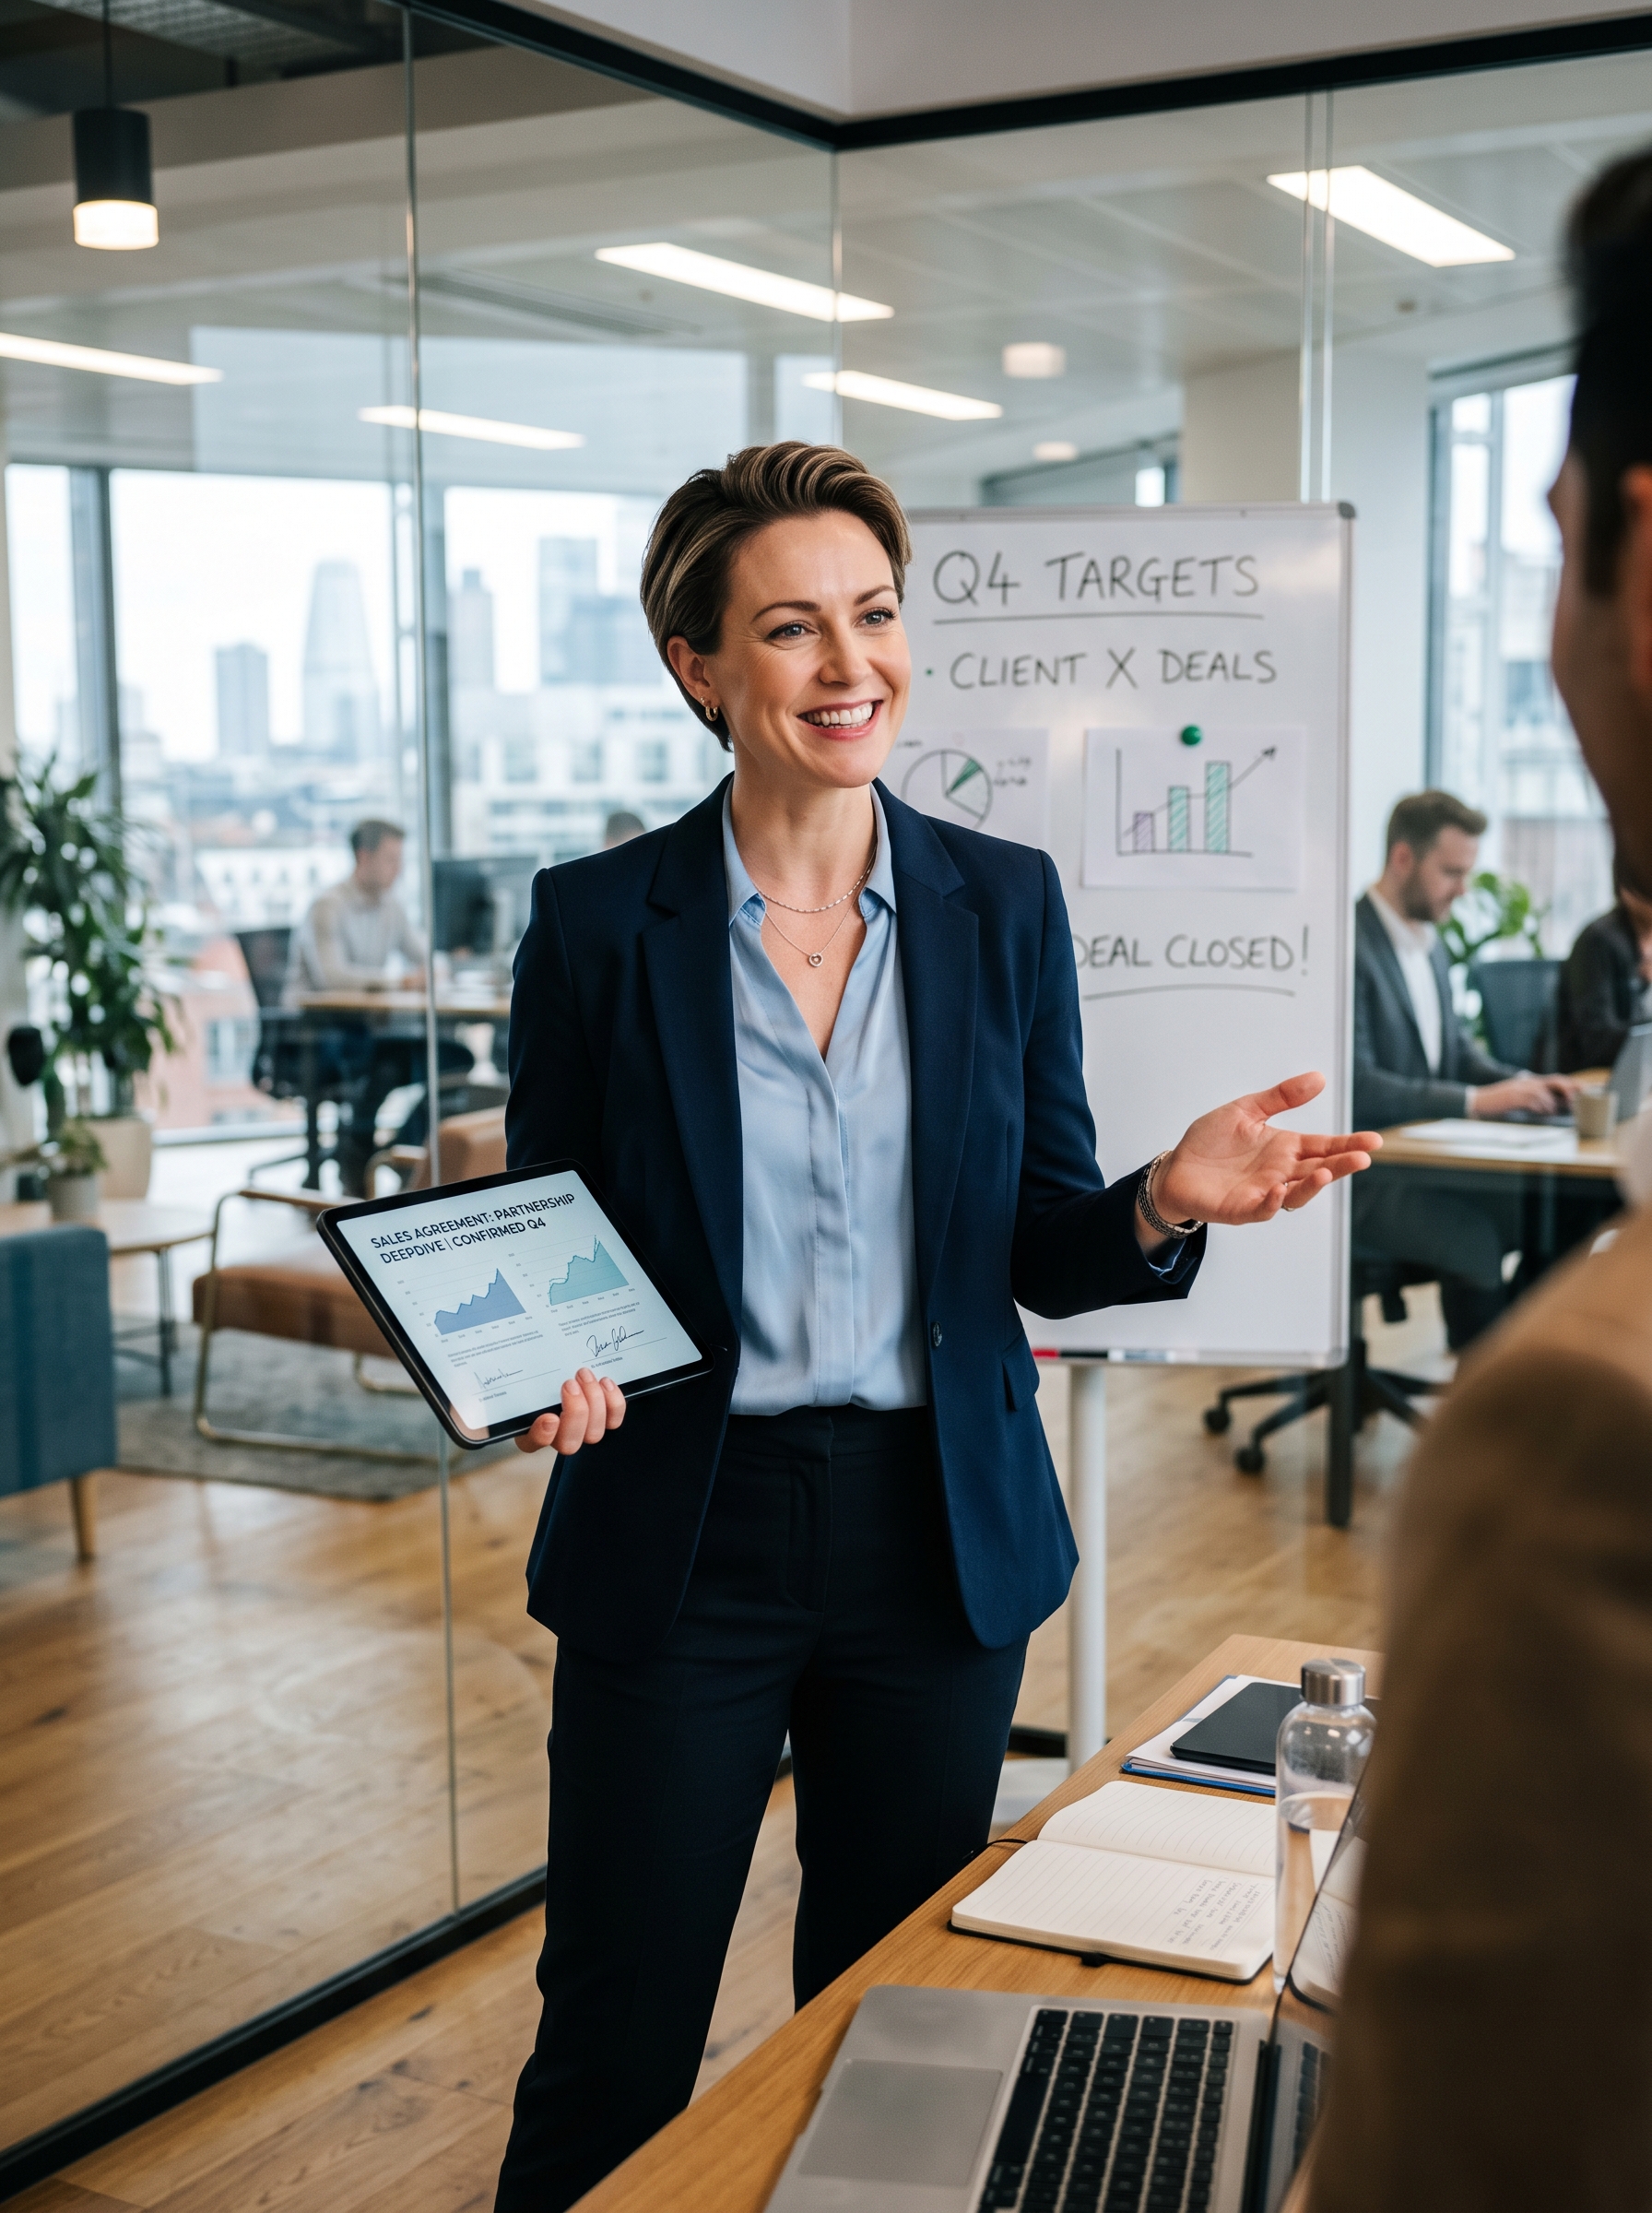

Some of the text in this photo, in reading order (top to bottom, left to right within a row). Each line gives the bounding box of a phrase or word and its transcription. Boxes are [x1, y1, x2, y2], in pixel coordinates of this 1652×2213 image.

[932, 550, 1259, 607] Q4 TARGETS
[949, 646, 1278, 690] CLIENT X DEALS
[1072, 924, 1310, 977] DEAL CLOSED!
[370, 1192, 575, 1249] SALES AGREEMENT: PARTNERSHIP
[379, 1239, 446, 1264] DEEPDIVE
[452, 1221, 526, 1248] CONFIRMED
[526, 1216, 547, 1230] Q4
